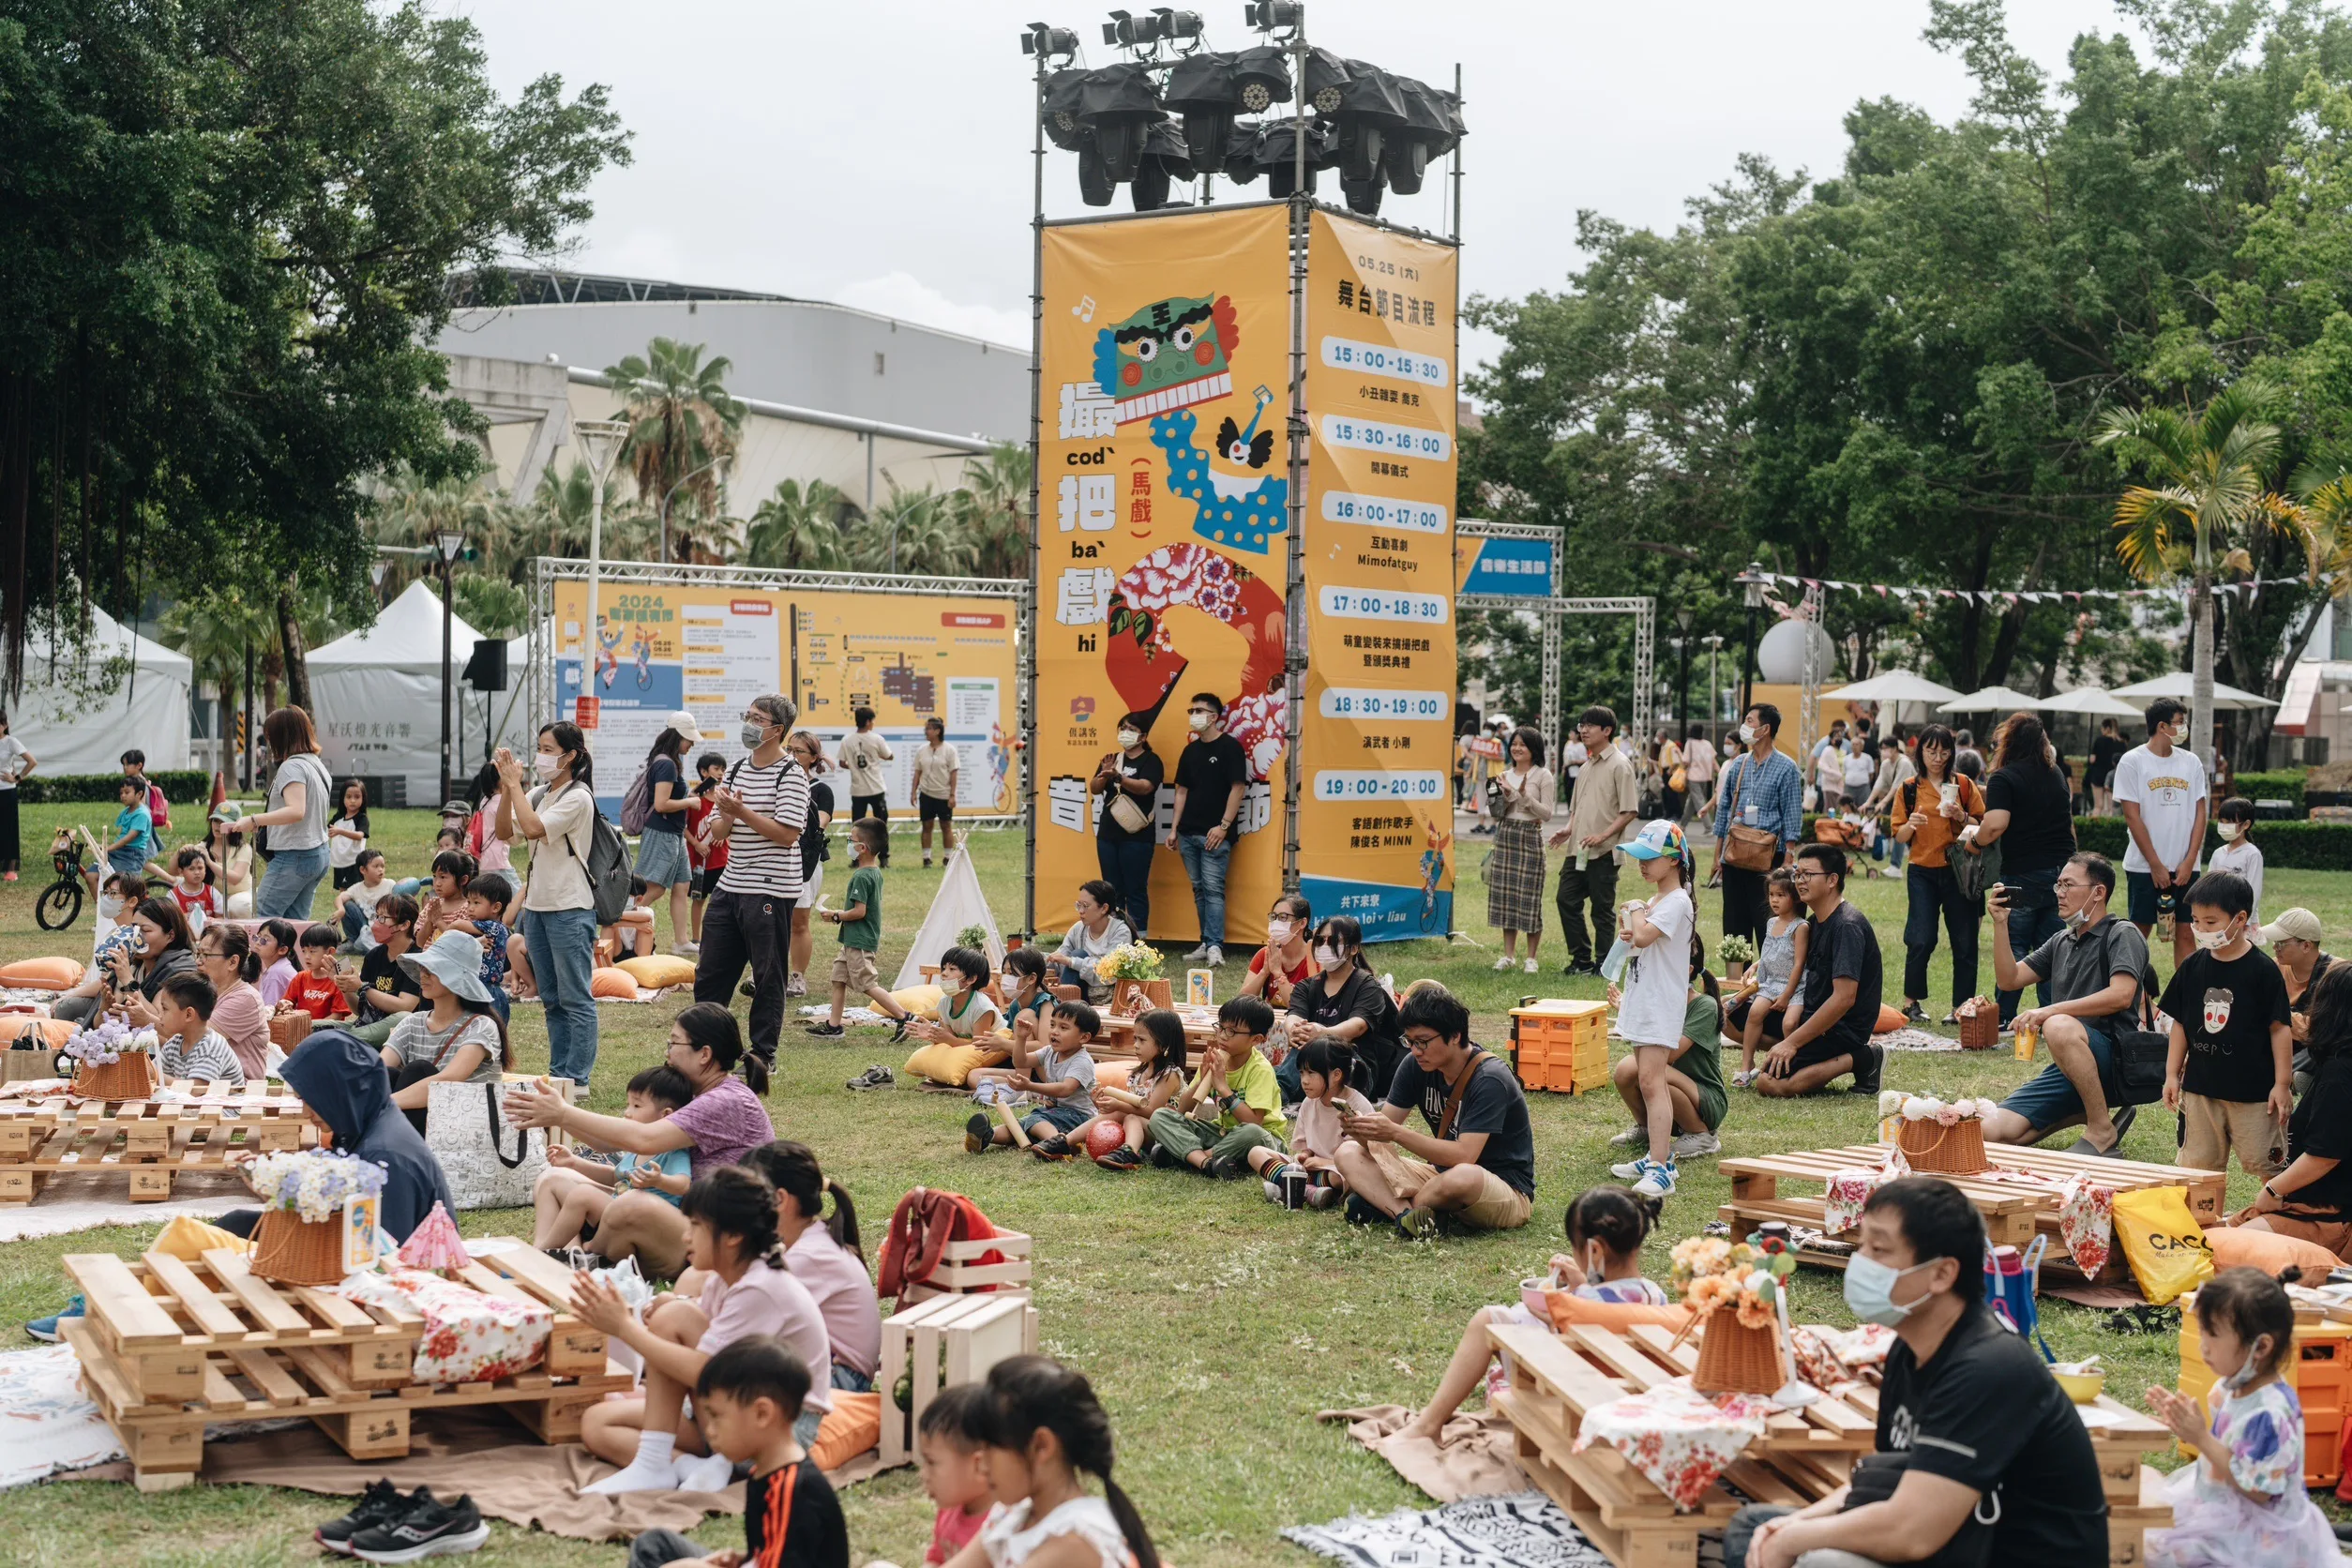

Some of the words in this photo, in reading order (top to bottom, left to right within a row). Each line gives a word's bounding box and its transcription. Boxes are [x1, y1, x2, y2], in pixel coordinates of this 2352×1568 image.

[1359, 255, 1395, 275] 05.25
[1338, 279, 1435, 326] 舞台節目流程
[1371, 461, 1410, 478] 開幕儀式
[1057, 474, 1117, 533] 把
[1370, 535, 1409, 551] 互動喜劇
[1357, 553, 1418, 572] Mimofatguy
[619, 595, 664, 609] 2024
[1078, 633, 1096, 652] hi
[1363, 654, 1410, 669] 暨頒獎典禮
[1351, 817, 1413, 830] 客語創作歌手
[1350, 836, 1380, 849] 陳俊名
[1383, 835, 1412, 846] MINN
